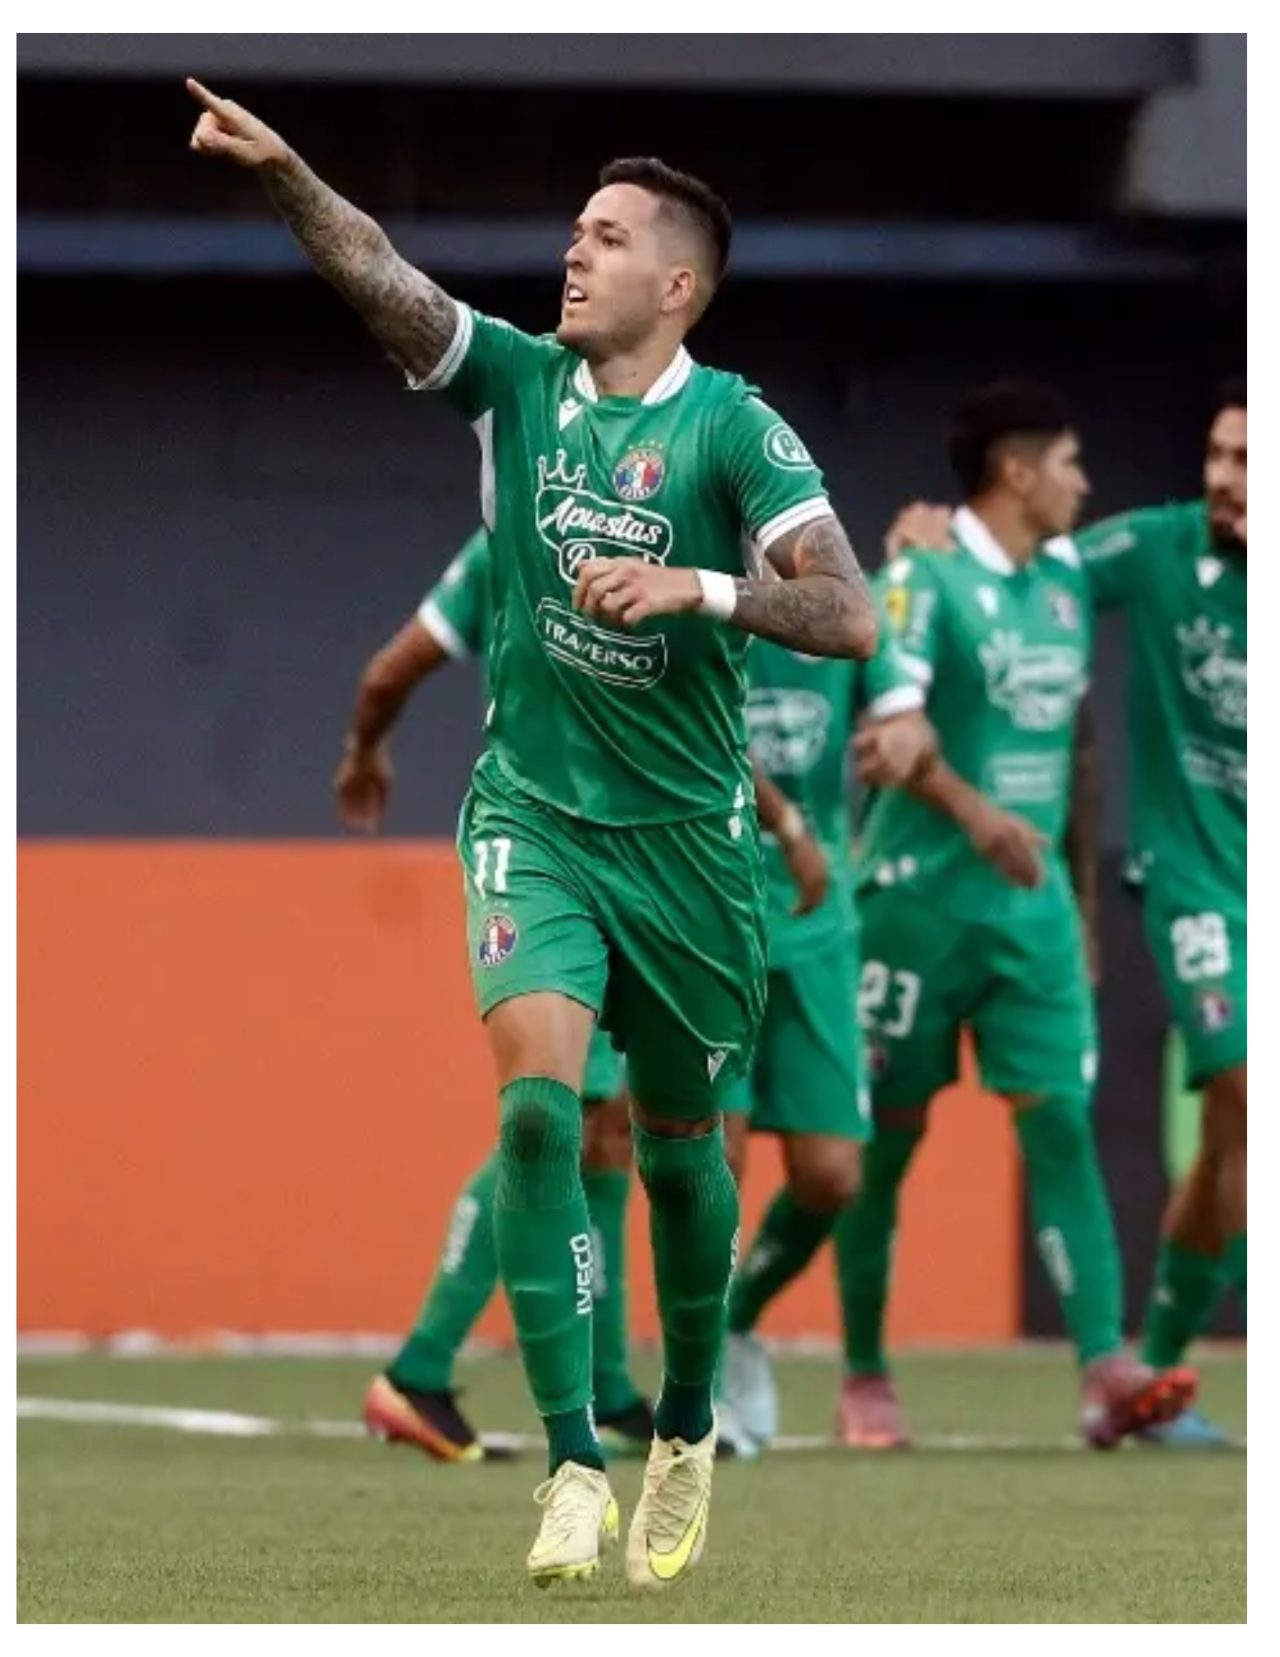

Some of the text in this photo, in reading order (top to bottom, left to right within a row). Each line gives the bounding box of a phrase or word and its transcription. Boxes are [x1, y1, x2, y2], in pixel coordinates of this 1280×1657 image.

[540, 496, 663, 545] Apuestas
[542, 617, 653, 673] TRAVERSO
[856, 958, 923, 1039] 23
[569, 1232, 590, 1315] IVECO
